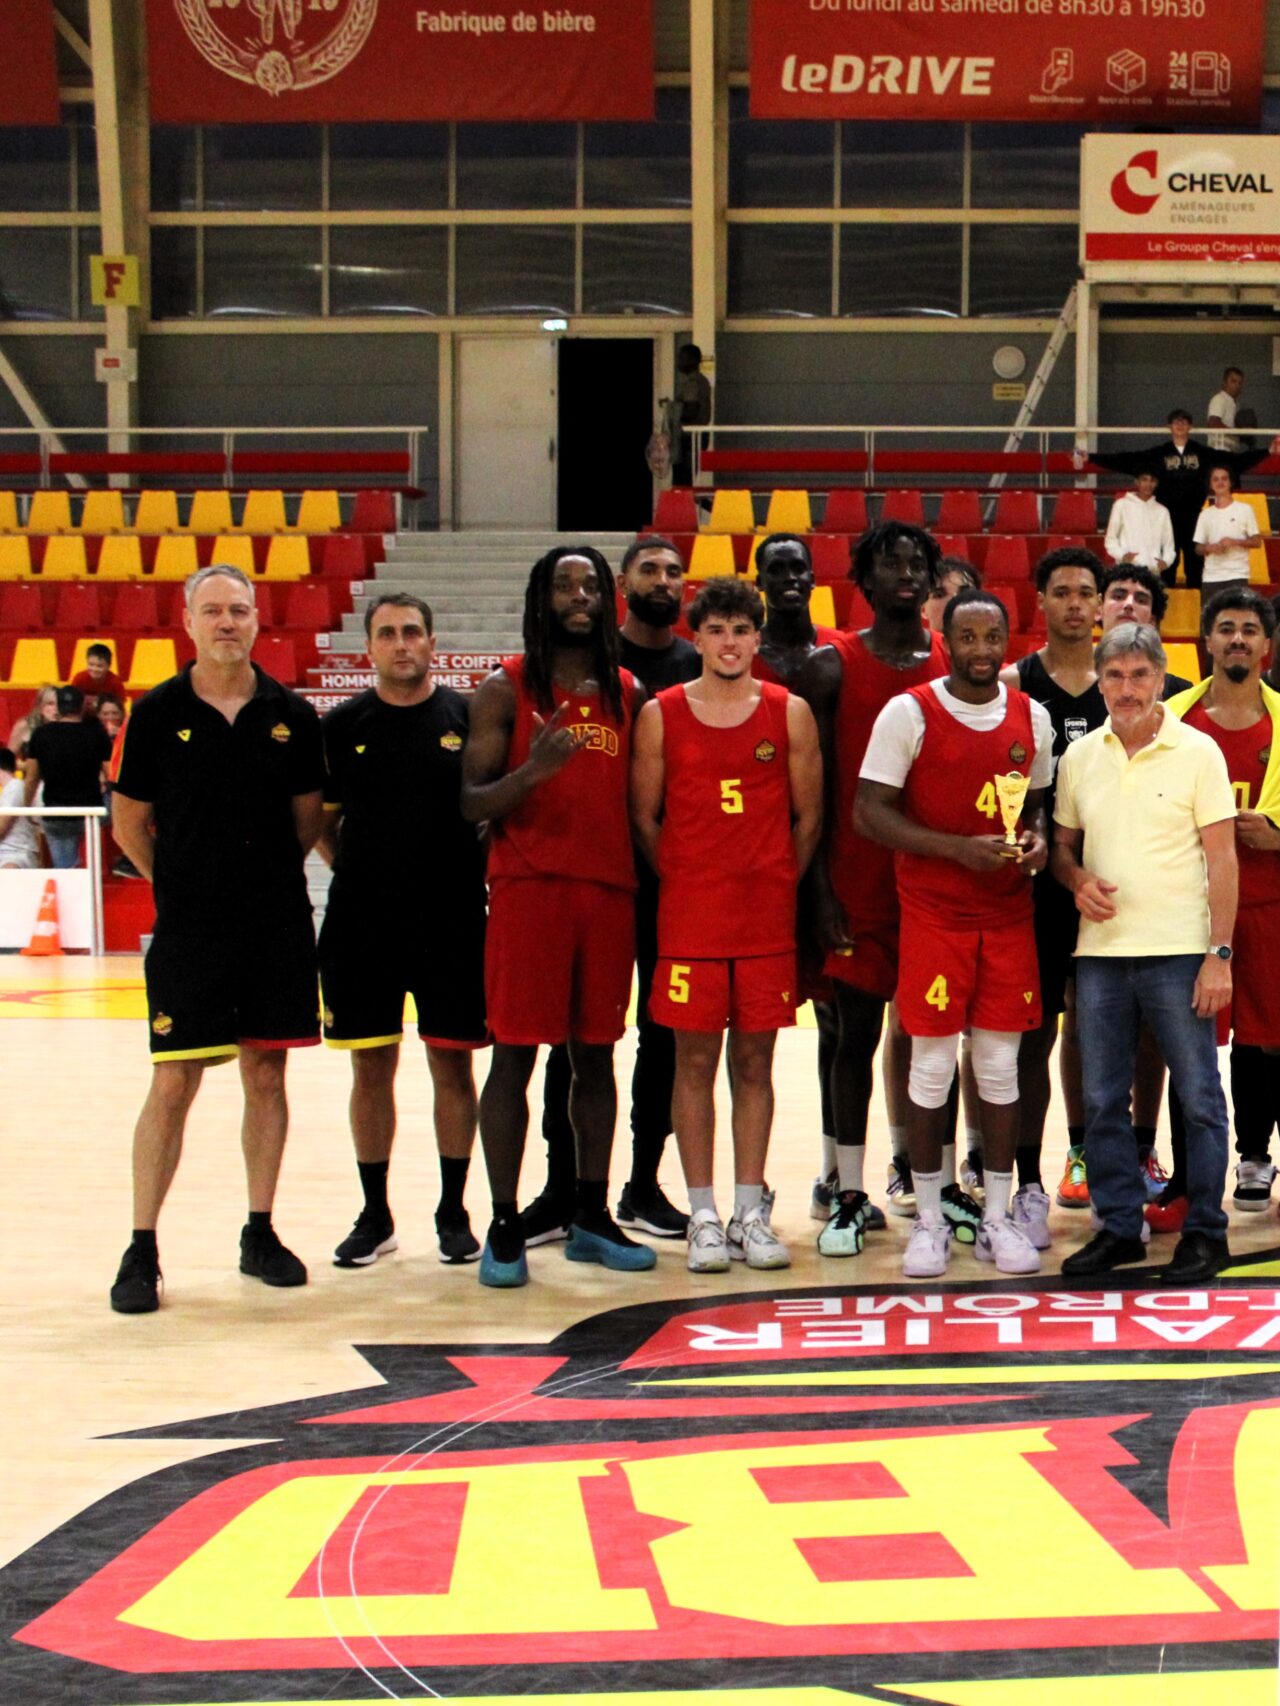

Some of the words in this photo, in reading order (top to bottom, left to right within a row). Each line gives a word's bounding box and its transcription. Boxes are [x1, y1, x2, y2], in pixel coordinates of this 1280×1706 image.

[908, 0, 934, 12] au
[1026, 0, 1053, 14] de
[1059, 0, 1114, 16] 8h30
[1142, 0, 1206, 17] 19h30
[416, 11, 506, 36] Fabrique
[512, 11, 537, 32] de
[543, 10, 596, 32] bière
[1169, 51, 1188, 67] 24
[1169, 75, 1188, 89] 24
[1167, 172, 1274, 193] CHEVAL
[1148, 241, 1163, 252] Le
[1165, 241, 1210, 255] Groupe
[1212, 241, 1253, 253] Cheval
[103, 263, 125, 298] F
[720, 779, 744, 814] 5
[975, 781, 998, 819] 4
[668, 964, 691, 1003] 5
[924, 974, 950, 1011] 4
